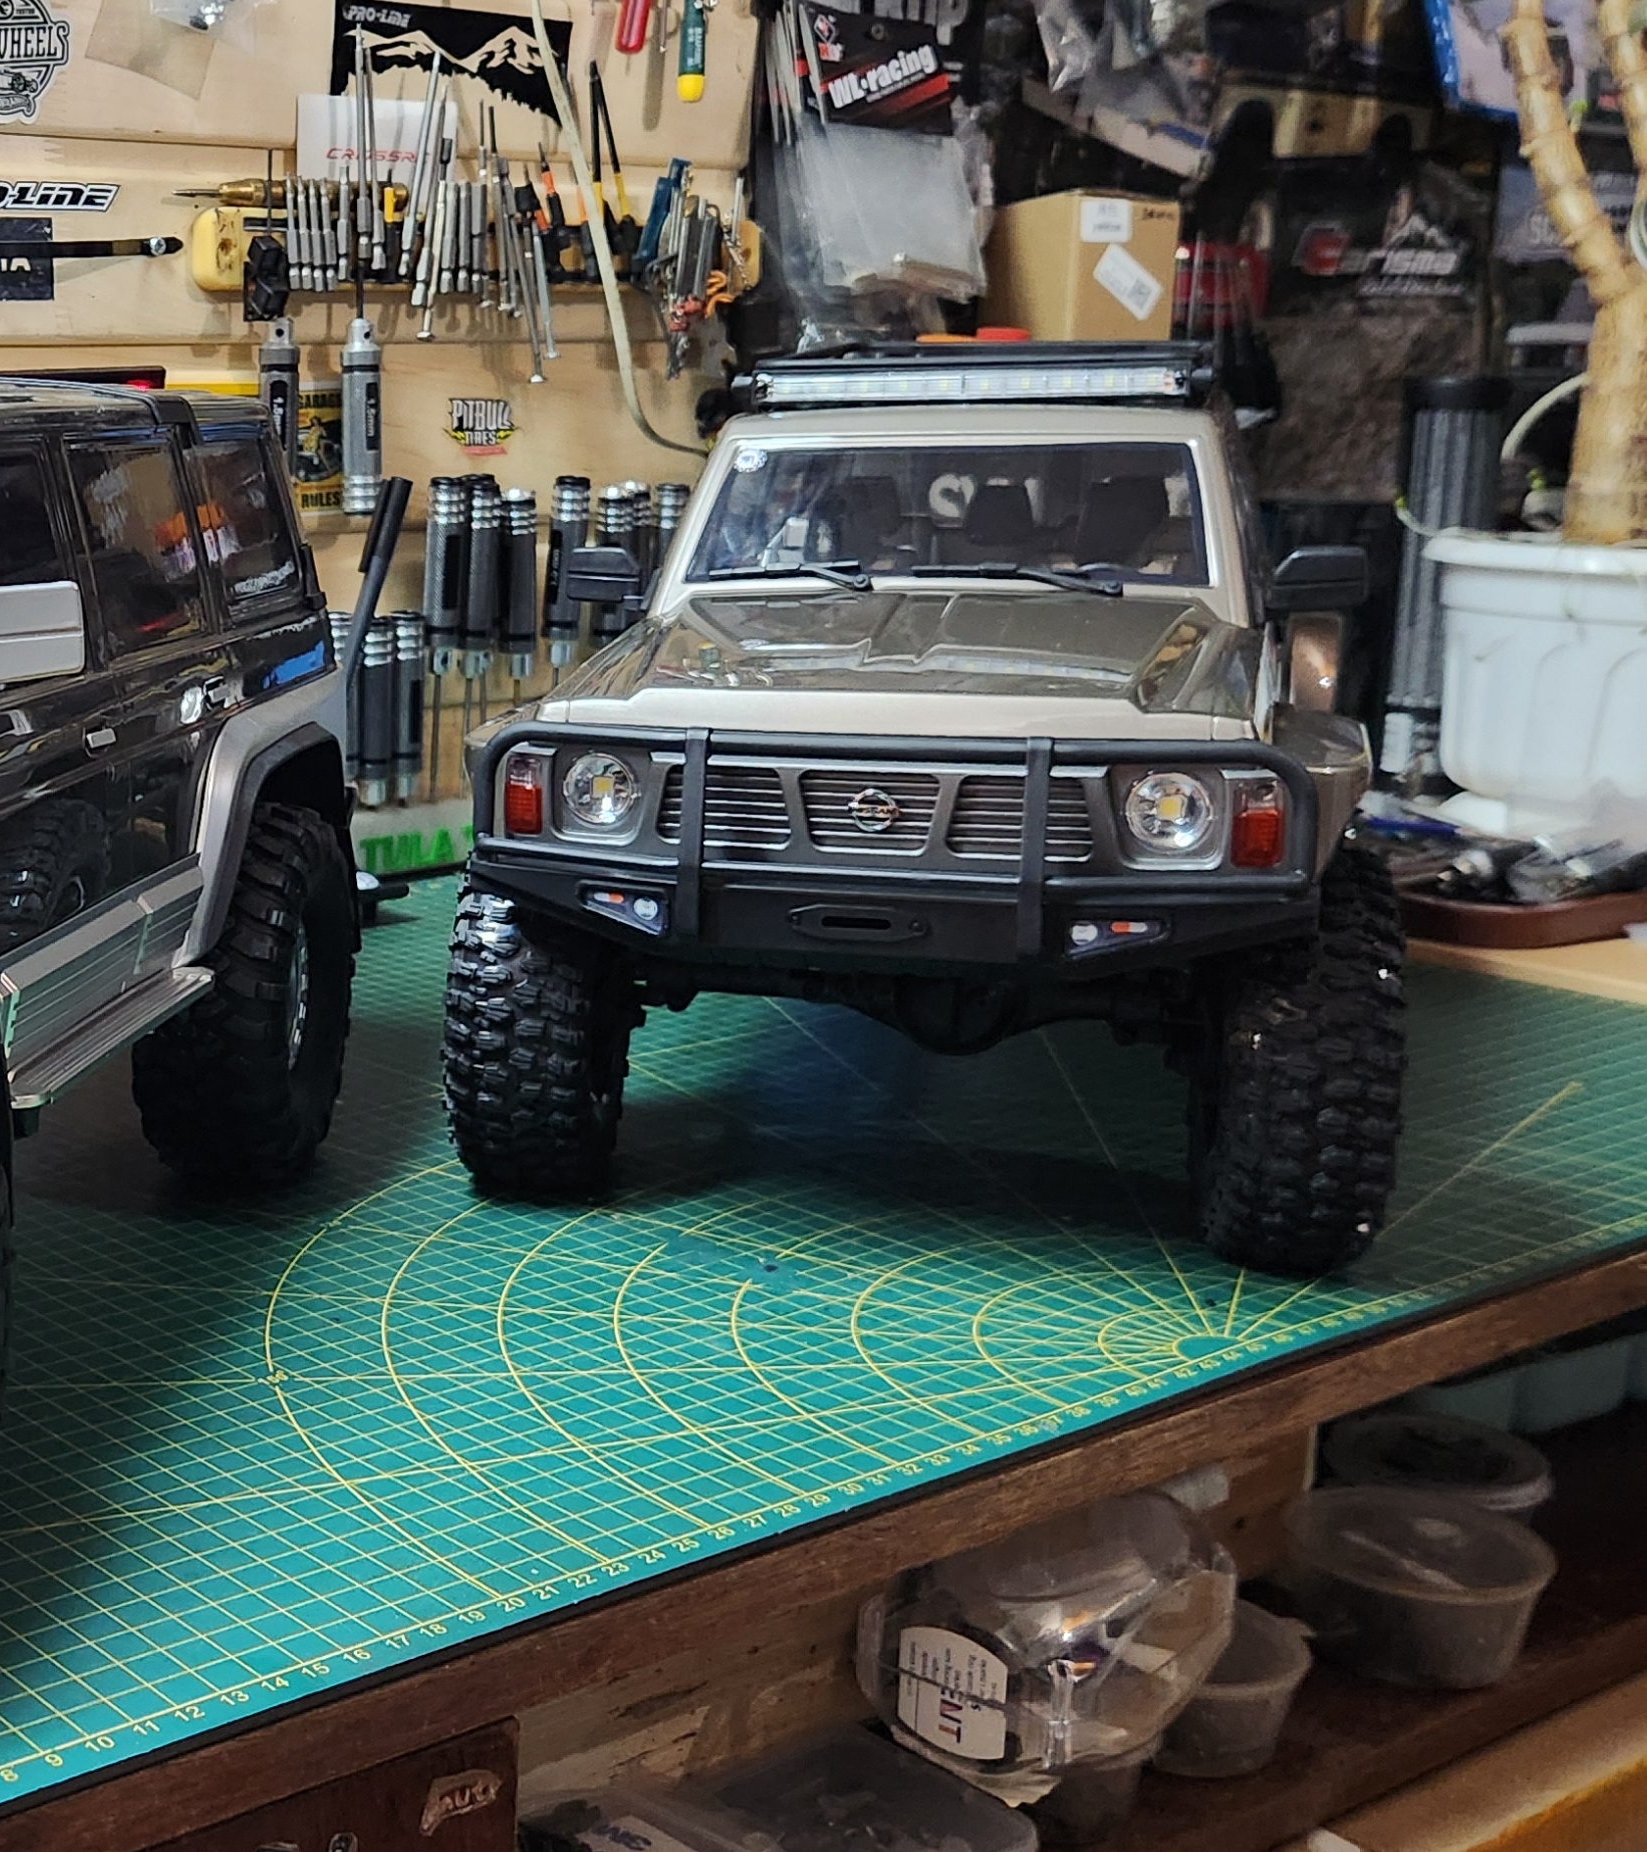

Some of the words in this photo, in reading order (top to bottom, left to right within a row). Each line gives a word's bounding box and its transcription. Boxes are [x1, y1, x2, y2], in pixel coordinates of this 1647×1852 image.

[301, 491, 341, 509] RULES
[84, 1735, 116, 1752] 10
[132, 1720, 161, 1736] 11
[174, 1705, 206, 1722] 12
[219, 1689, 251, 1707] 13
[260, 1675, 290, 1692] 14
[300, 1661, 331, 1679] 15
[342, 1648, 372, 1665] 16
[384, 1634, 411, 1650] 17
[419, 1622, 448, 1638] 18
[458, 1609, 487, 1625] 19
[495, 1596, 527, 1613] 20
[531, 1585, 561, 1601] 21
[566, 1572, 599, 1589] 22
[600, 1561, 631, 1578] 23
[637, 1549, 667, 1565] 24
[671, 1538, 701, 1553] 25
[706, 1525, 736, 1541] 26
[741, 1513, 769, 1529] 27
[772, 1503, 802, 1518] 28
